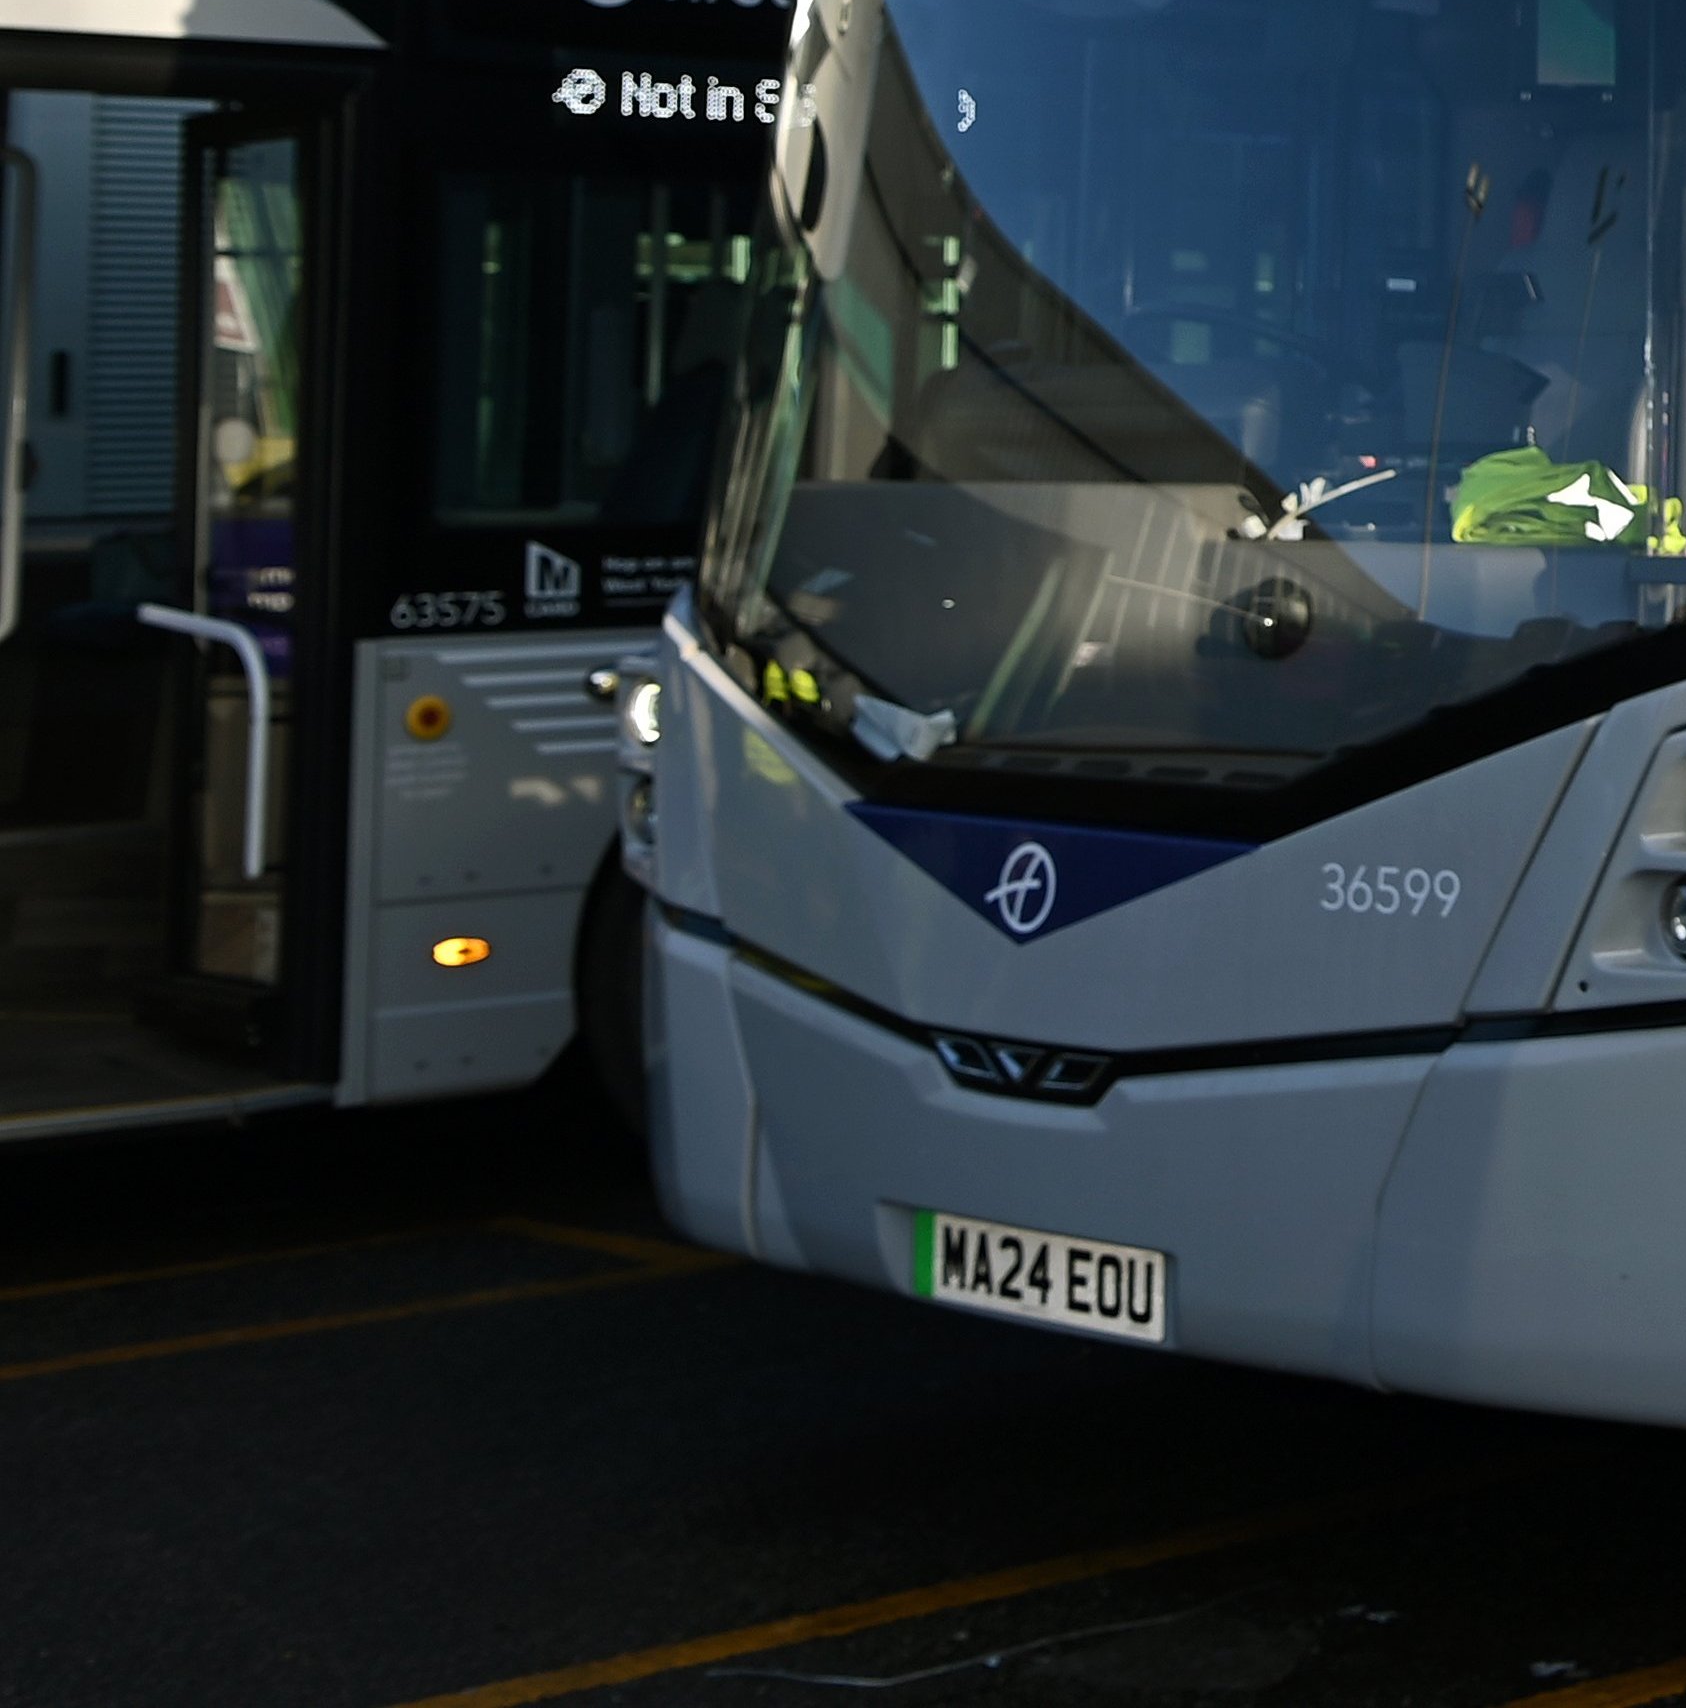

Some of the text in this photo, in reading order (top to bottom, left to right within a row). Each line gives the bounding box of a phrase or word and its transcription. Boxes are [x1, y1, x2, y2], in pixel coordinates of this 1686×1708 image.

[620, 71, 696, 120] Not
[706, 75, 745, 122] in
[389, 590, 507, 630] 63575
[1320, 861, 1462, 919] 36599
[941, 1224, 1155, 1325] MA24 EOU
